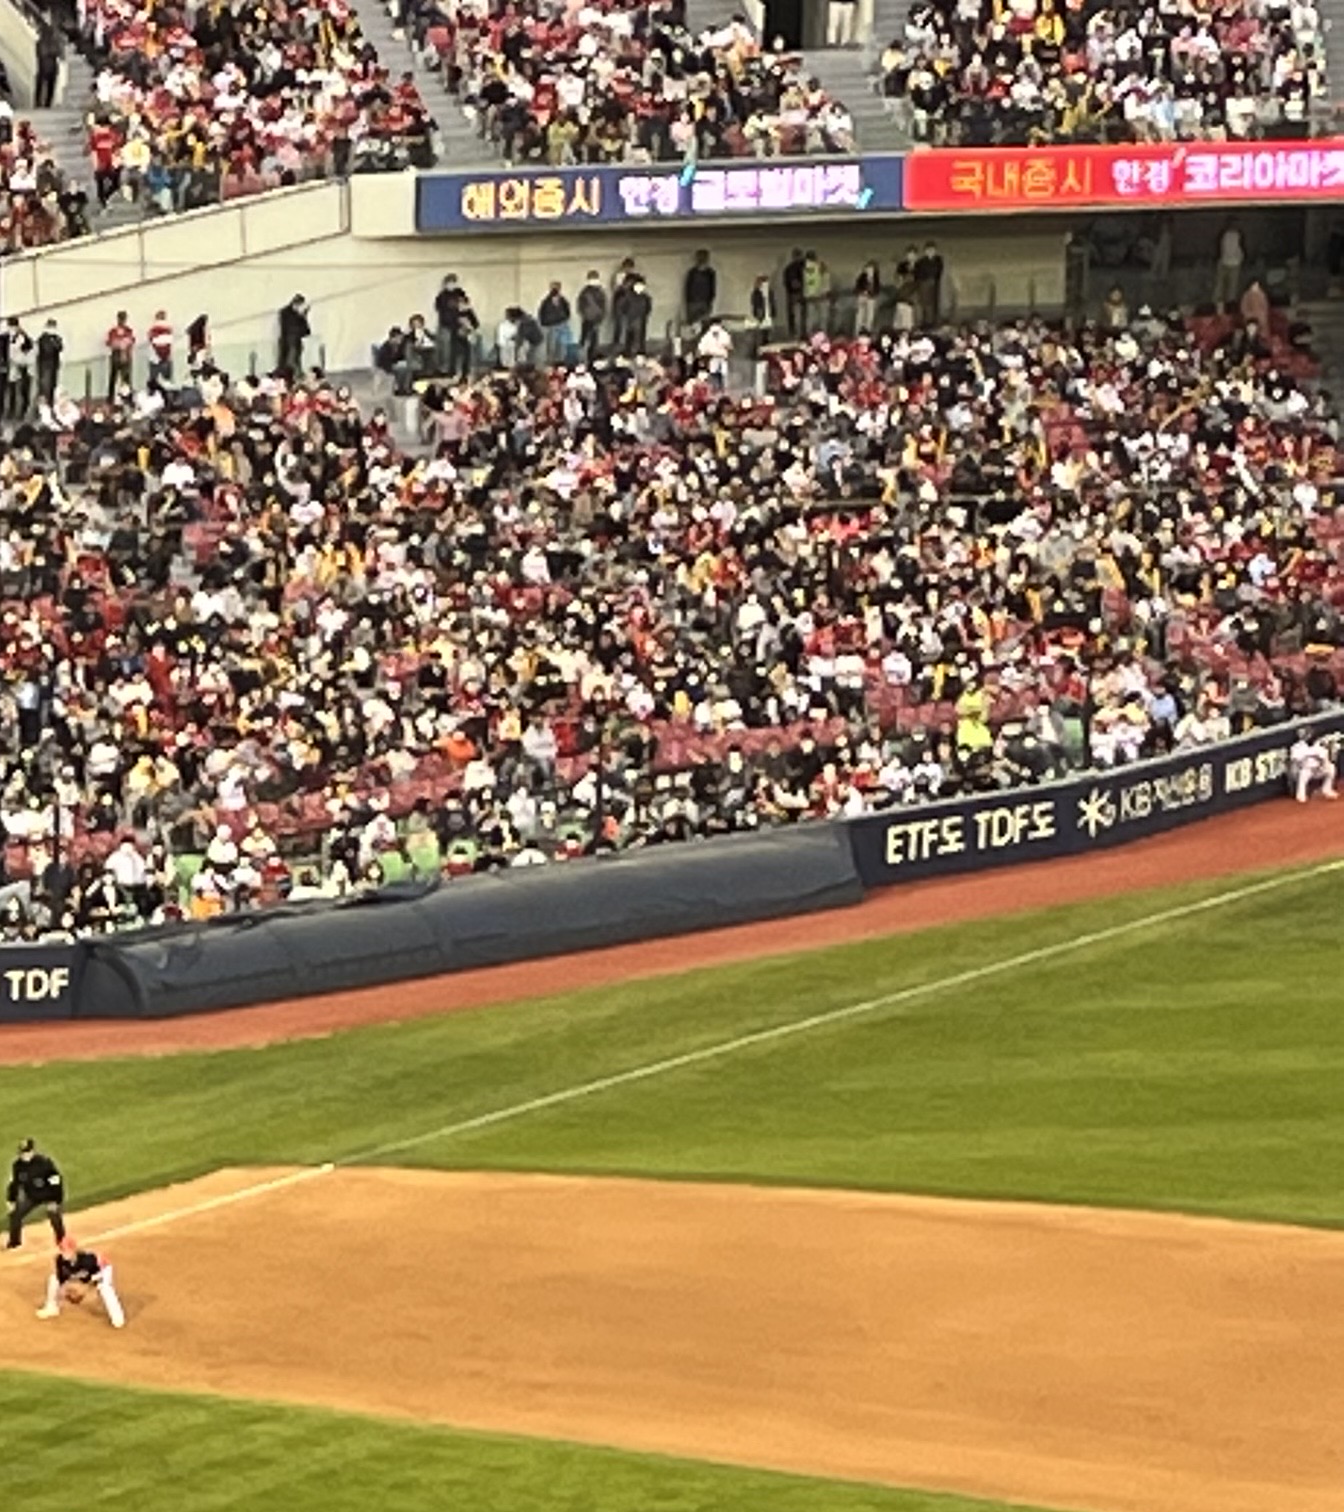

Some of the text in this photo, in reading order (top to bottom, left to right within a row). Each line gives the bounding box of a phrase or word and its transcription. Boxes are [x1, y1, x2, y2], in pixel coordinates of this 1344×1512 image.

[462, 176, 600, 221] 해외증시
[950, 157, 1092, 200] 국내증시
[4, 968, 69, 1000] TDF
